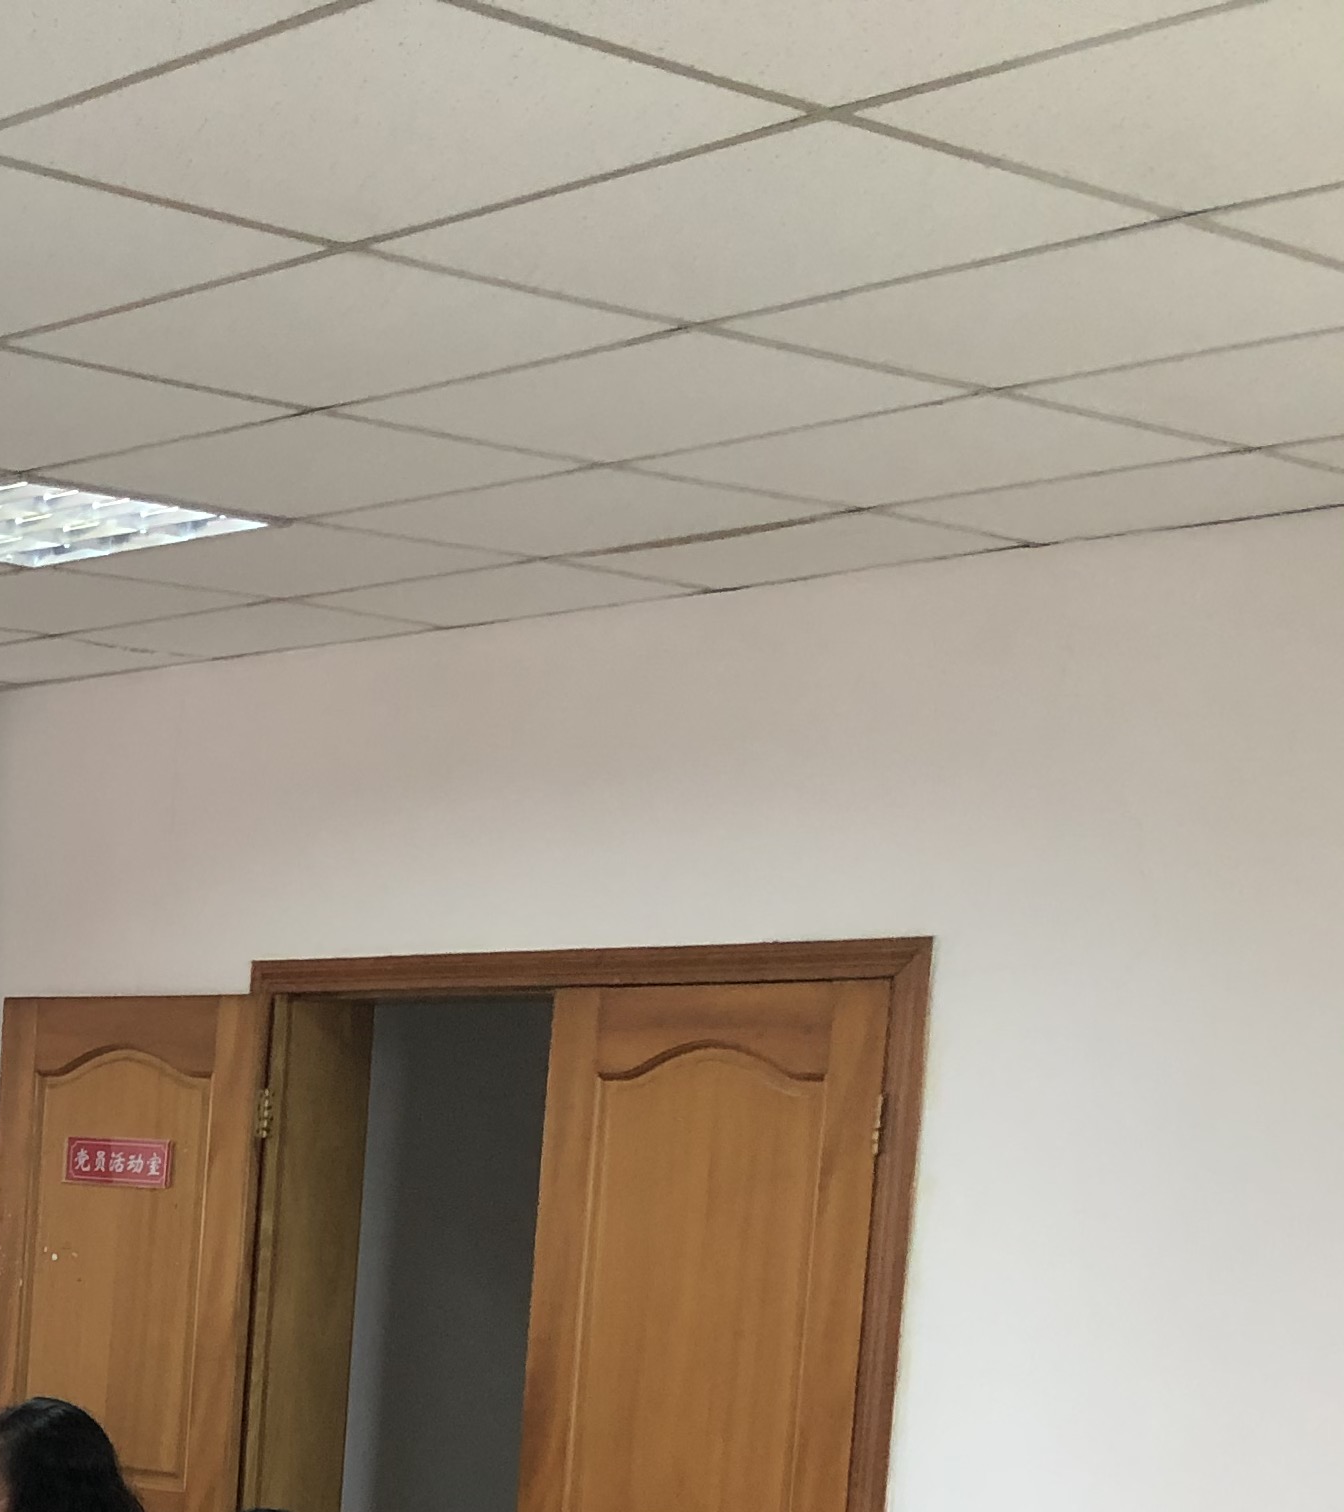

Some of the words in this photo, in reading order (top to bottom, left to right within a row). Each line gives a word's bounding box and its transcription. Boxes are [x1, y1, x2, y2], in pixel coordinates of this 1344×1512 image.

[73, 1148, 162, 1176] 党员活动室
